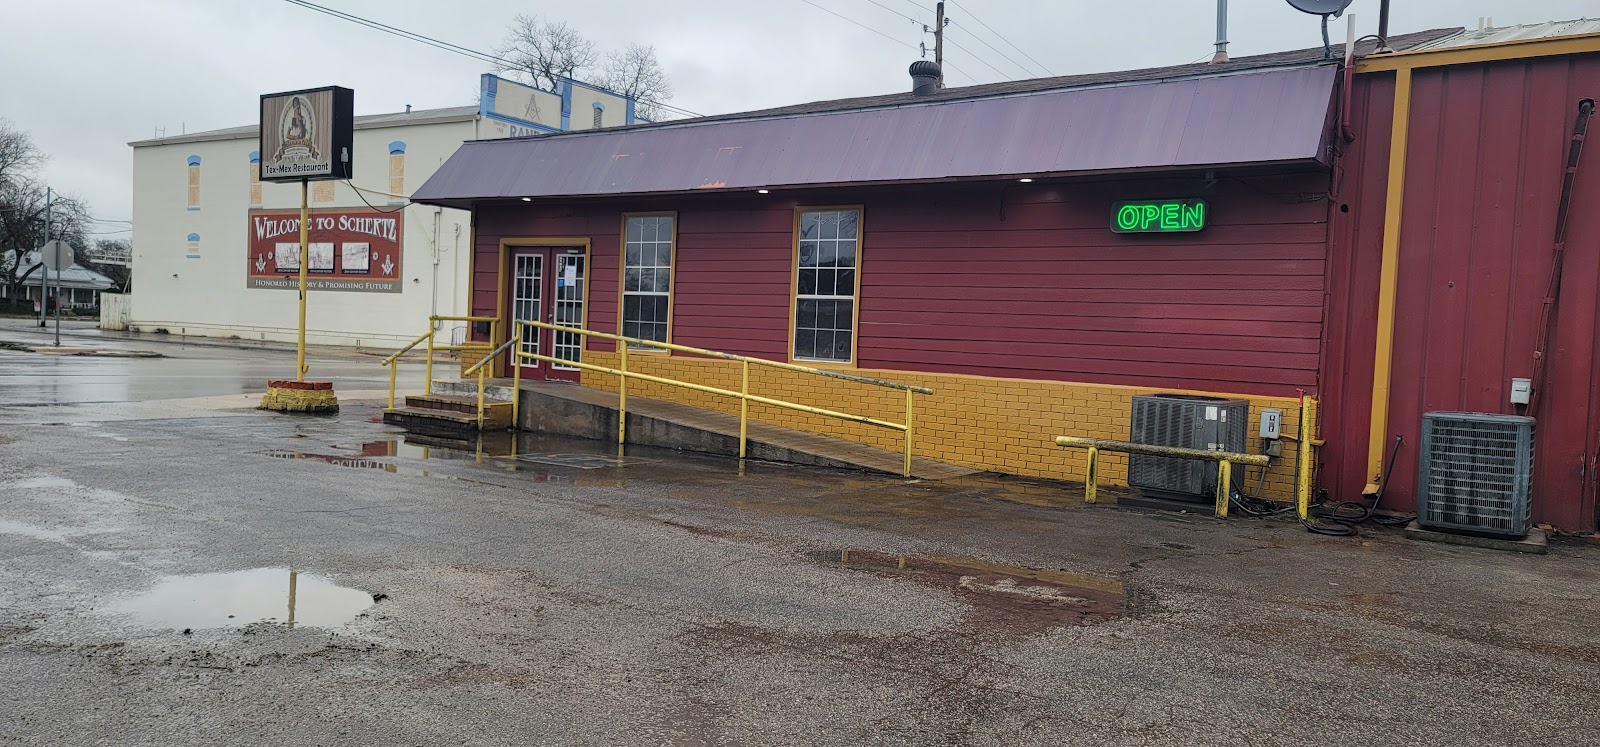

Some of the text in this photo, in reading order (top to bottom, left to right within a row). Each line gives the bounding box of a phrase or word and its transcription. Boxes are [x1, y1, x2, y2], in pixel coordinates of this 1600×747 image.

[265, 162, 329, 174] Tex-Mex Restaurant
[1117, 203, 1203, 229] OPEN
[316, 217, 335, 230] TO
[338, 215, 397, 242] SCHERTZ
[255, 279, 288, 287] HONORED
[289, 280, 317, 288] HISORY
[325, 281, 364, 290] PROMISING
[365, 282, 393, 290] FUTURE
